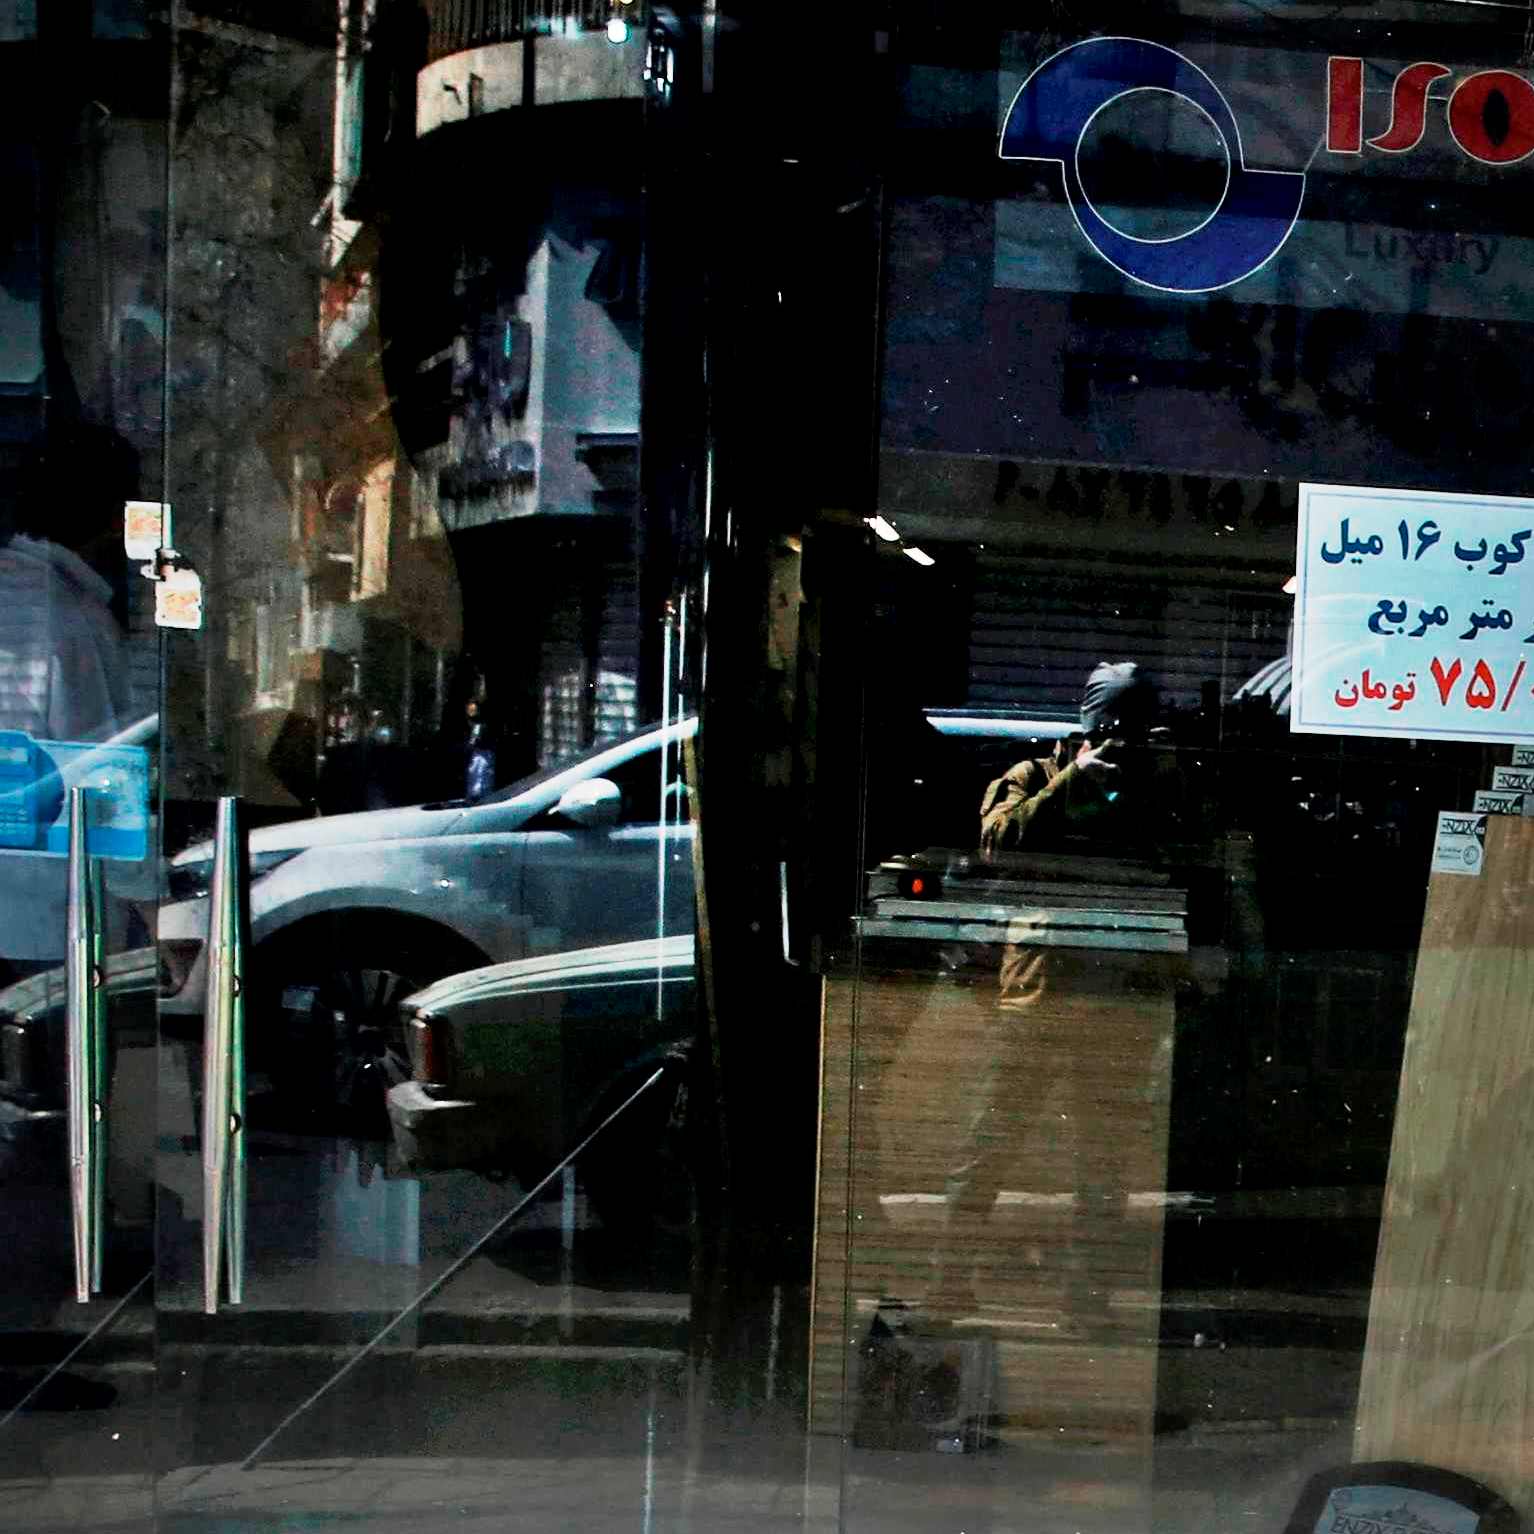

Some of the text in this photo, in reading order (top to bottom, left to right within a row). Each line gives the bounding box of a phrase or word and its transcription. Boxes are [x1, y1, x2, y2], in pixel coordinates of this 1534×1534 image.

[1345, 222, 1498, 276] Luxury
[1320, 517, 1384, 565] میل
[1397, 518, 1442, 561] ۱۶
[1454, 529, 1532, 575] کوب
[1367, 598, 1449, 637] مربع
[1458, 598, 1513, 640] متر
[1334, 668, 1416, 711] تومان
